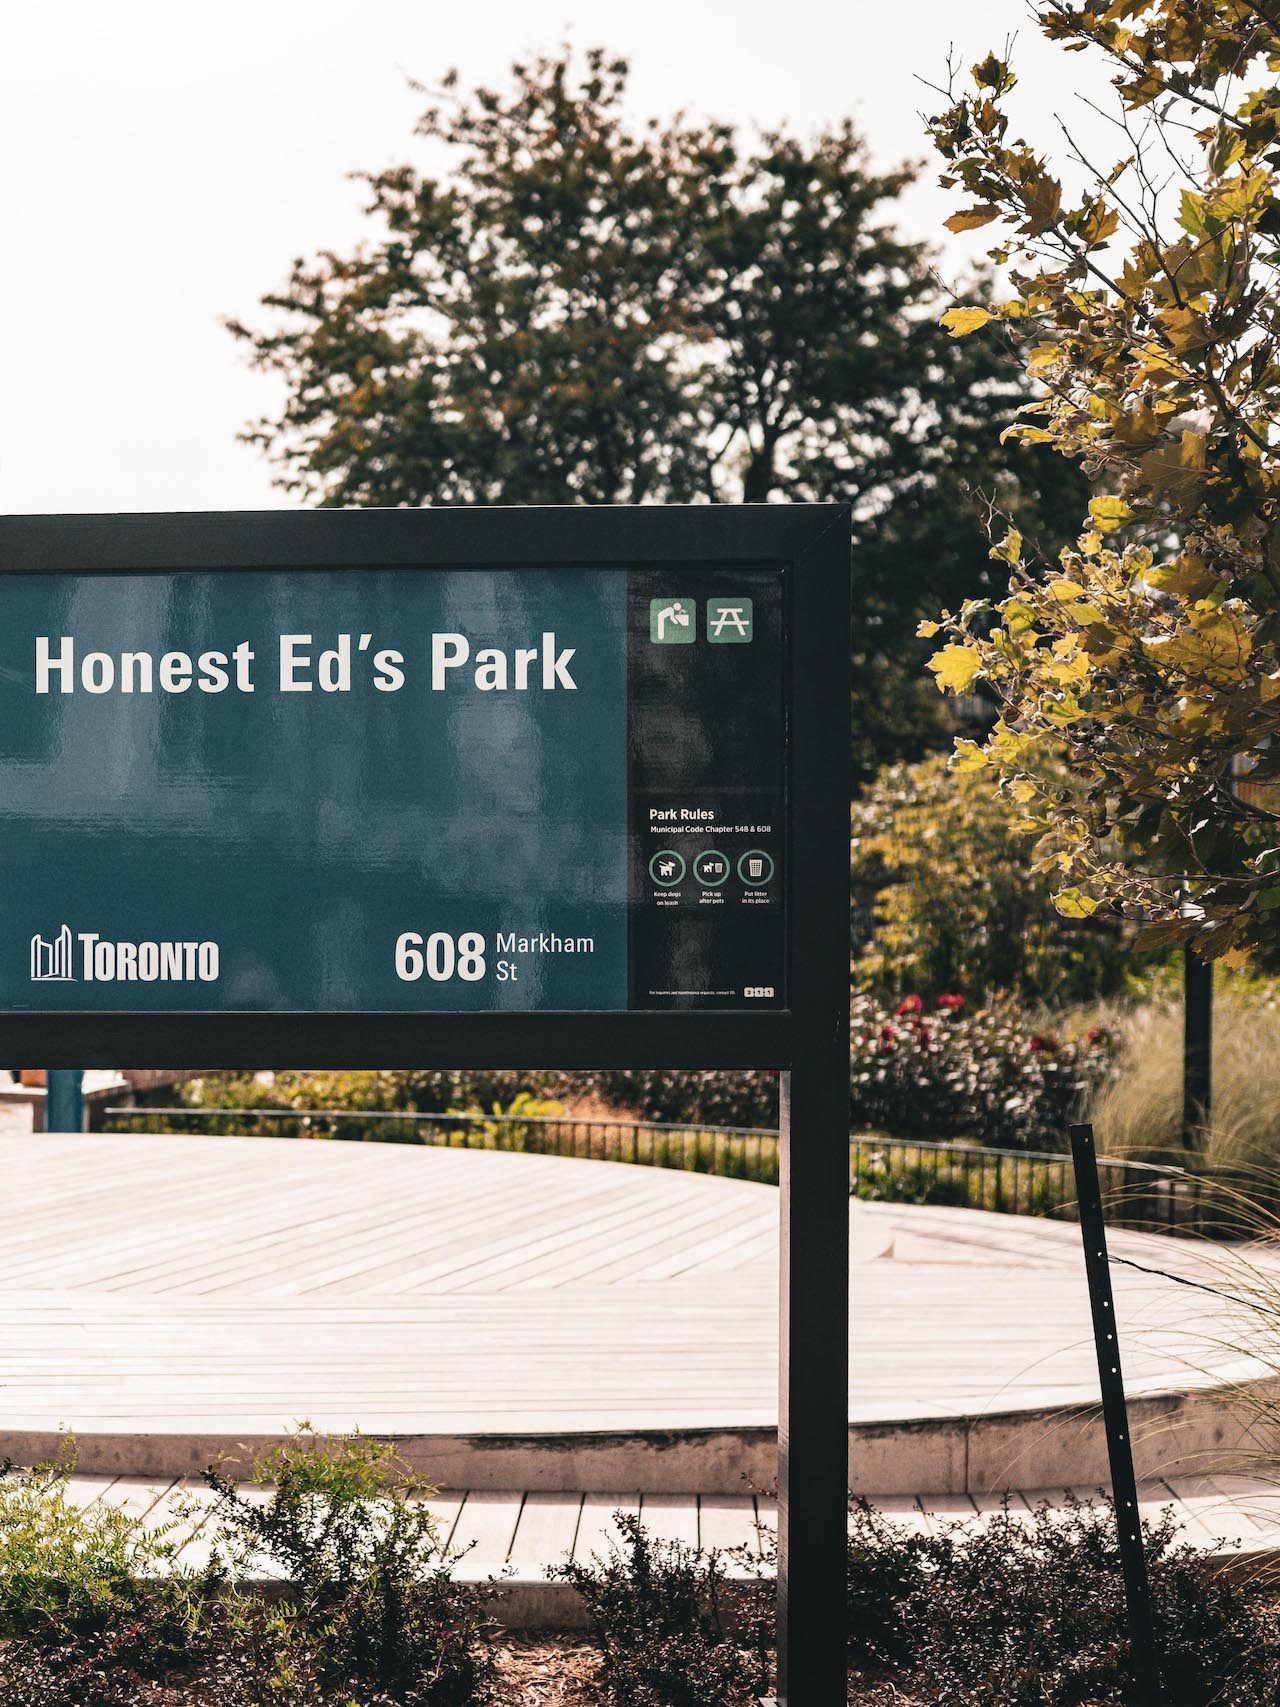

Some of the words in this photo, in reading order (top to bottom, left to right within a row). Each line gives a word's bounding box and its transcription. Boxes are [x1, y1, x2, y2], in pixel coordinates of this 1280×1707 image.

[35, 636, 255, 694] Honest
[279, 634, 405, 692] Ed's
[432, 632, 578, 691] Park
[649, 808, 678, 820] Park
[680, 808, 715, 820] Rules
[650, 826, 684, 834] Municipal
[705, 826, 734, 834] Chapter
[496, 932, 594, 953] Markham
[78, 933, 219, 982] TORONTO
[395, 932, 486, 982] 608
[496, 960, 518, 981] St
